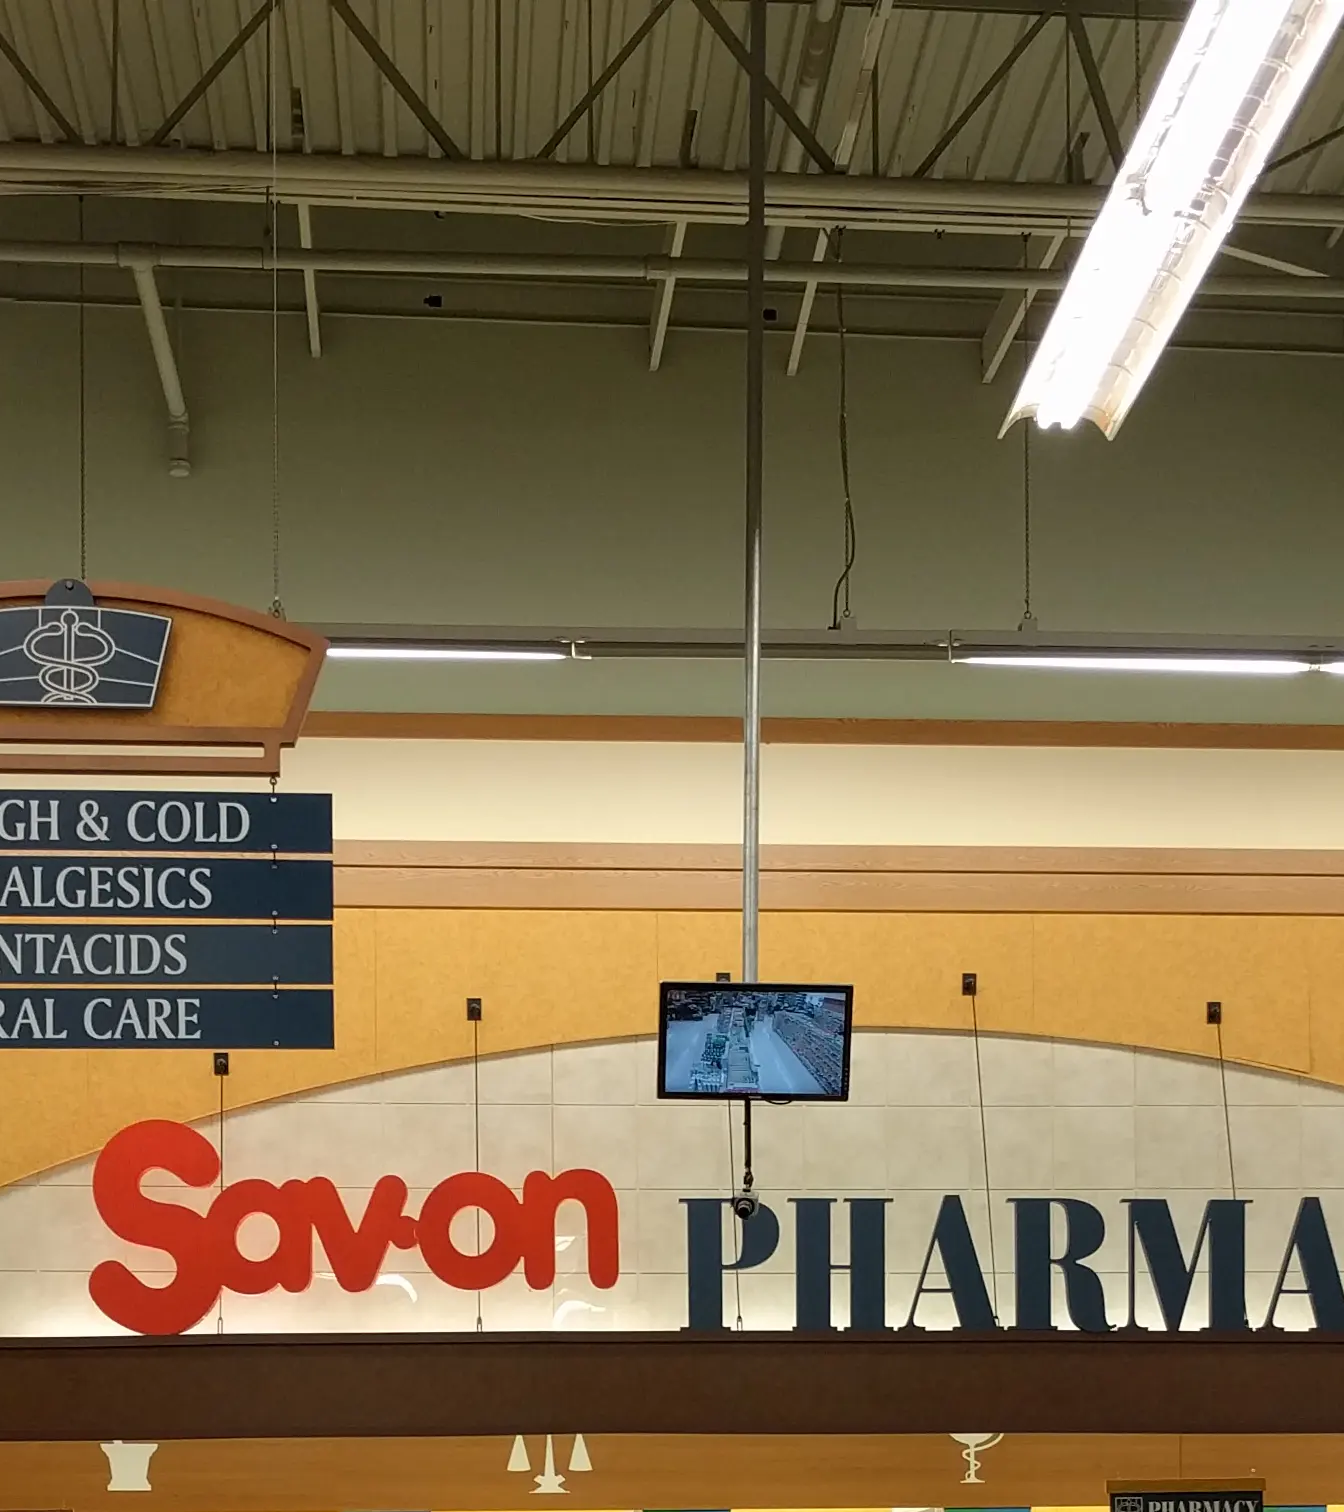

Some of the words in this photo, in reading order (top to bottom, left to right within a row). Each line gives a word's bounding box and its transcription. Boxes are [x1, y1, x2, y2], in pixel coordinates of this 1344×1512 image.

[76, 800, 110, 842] &
[127, 801, 251, 845] COLD
[83, 998, 202, 1040] CARE
